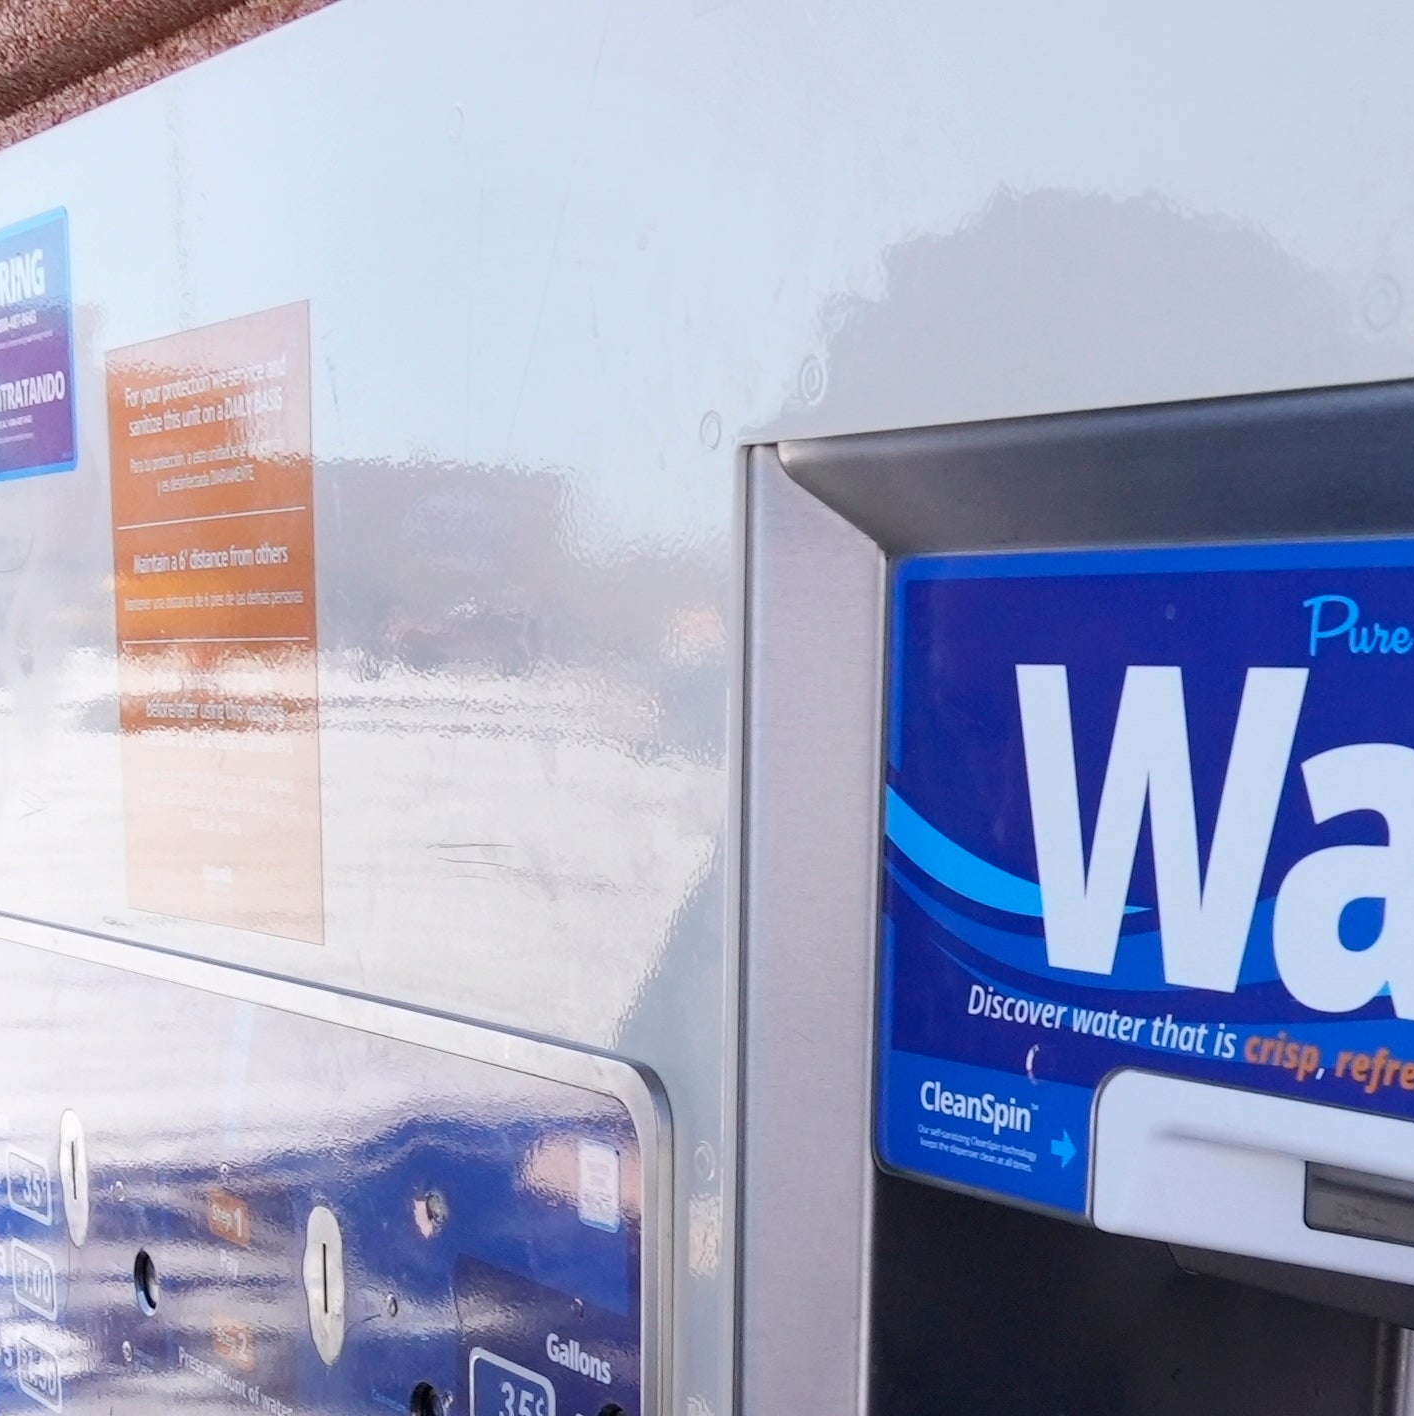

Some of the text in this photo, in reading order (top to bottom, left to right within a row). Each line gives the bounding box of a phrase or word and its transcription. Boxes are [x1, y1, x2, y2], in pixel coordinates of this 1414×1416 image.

[125, 387, 137, 408] For
[140, 386, 161, 409] your
[162, 375, 210, 405] protection
[129, 414, 162, 437] sanitize
[164, 409, 180, 430] this
[182, 405, 202, 427] unit
[203, 406, 216, 423] on
[217, 405, 223, 421] a
[225, 394, 252, 419] DAILY
[134, 554, 169, 574] Maintain
[170, 558, 177, 571] a
[189, 548, 228, 570] distance
[230, 544, 253, 566] from
[255, 541, 288, 565] others
[1303, 595, 1414, 656] Pure
[967, 984, 1068, 1030] Discover
[1072, 1007, 1146, 1042] water
[1150, 1013, 1205, 1055] that
[1213, 1022, 1236, 1059] is
[1244, 1031, 1325, 1081] crisp,
[212, 1204, 244, 1238] Step 1
[0, 1249, 7, 1275] 3
[237, 1333, 248, 1361] 2
[546, 1332, 612, 1385] Gallons
[178, 1346, 207, 1379] Press
[208, 1368, 246, 1397] amount
[247, 1385, 261, 1404] of
